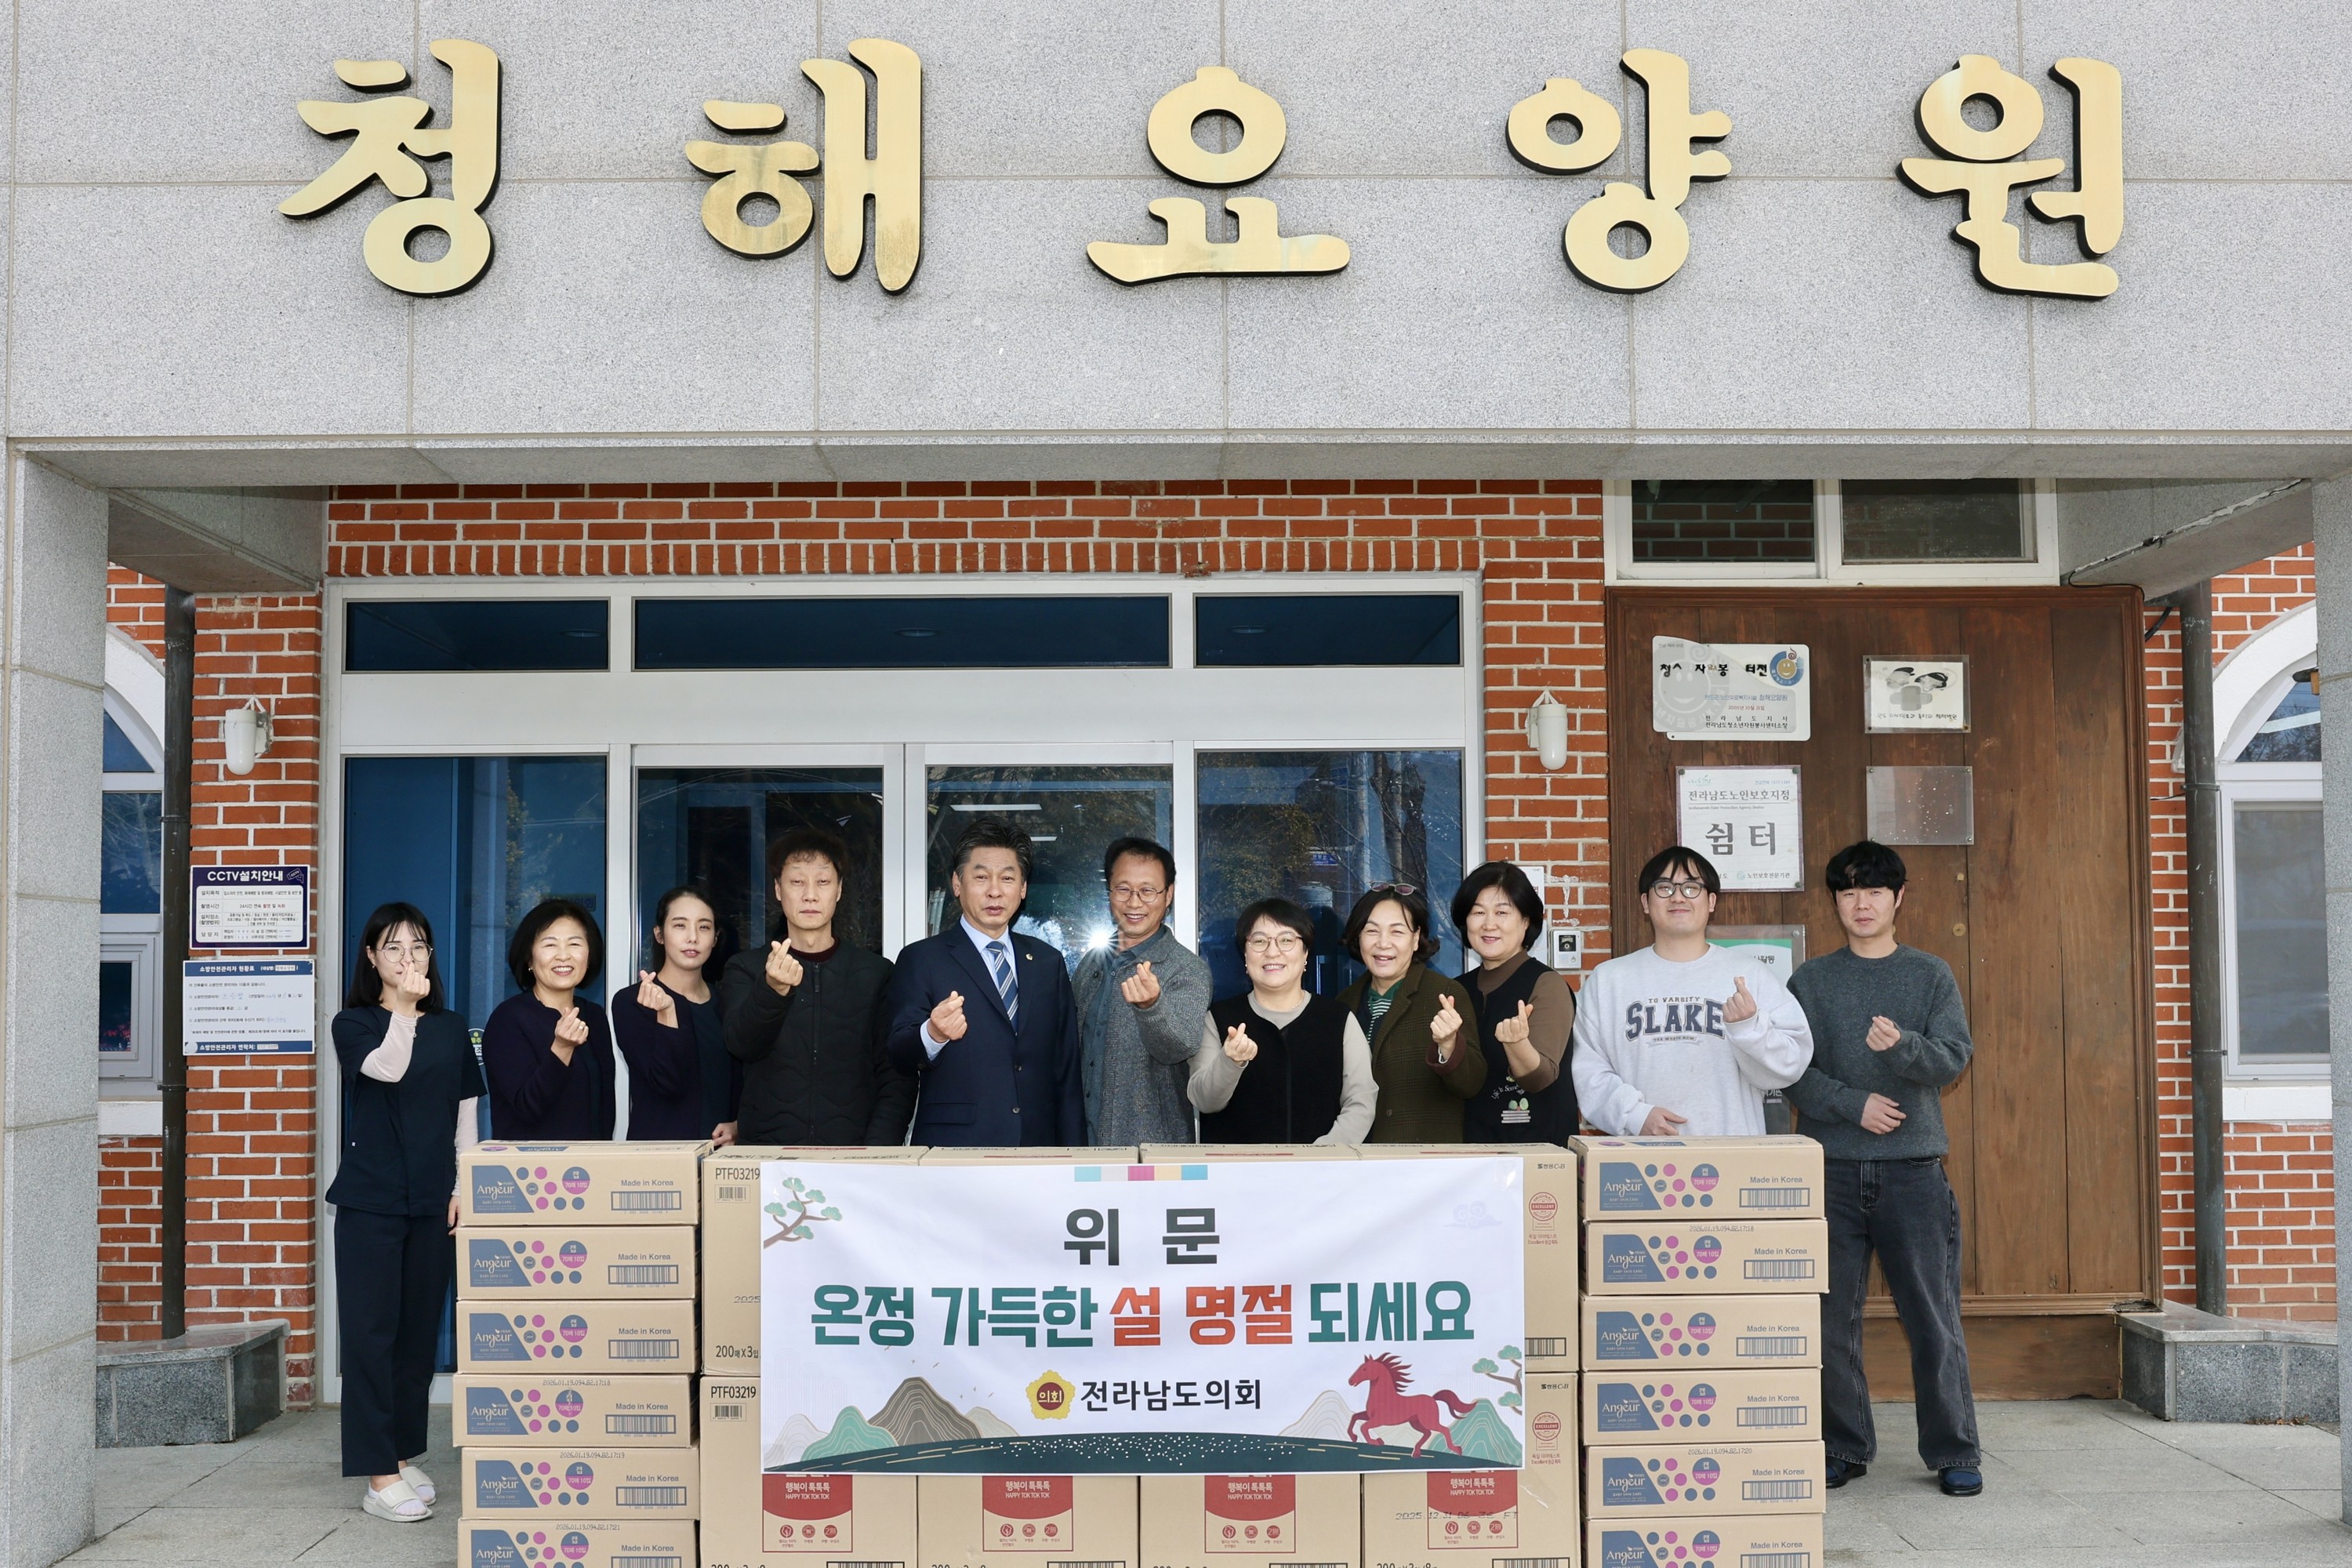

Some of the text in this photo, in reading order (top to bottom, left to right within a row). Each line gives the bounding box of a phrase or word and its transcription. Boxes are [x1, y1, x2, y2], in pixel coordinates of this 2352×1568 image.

[1688, 789, 1790, 801] 전라남도노인보호지정
[207, 870, 284, 881] CCTV설치안내
[1626, 998, 1725, 1042] SLAKE
[715, 1167, 760, 1180] PTF03219
[477, 1185, 514, 1200] Angeur
[1604, 1182, 1642, 1197] Angeur
[474, 1259, 512, 1274] Angeur
[1608, 1254, 1646, 1269] Angeur
[811, 1280, 1474, 1348] 온정 가득한 설 명절 되세요
[474, 1333, 512, 1348] Angeur
[1601, 1331, 1639, 1346] Angeur
[711, 1386, 757, 1399] PTF03219
[1038, 1389, 1062, 1403] 의회
[1081, 1379, 1261, 1412] 전라남도의회
[471, 1406, 509, 1421] Angeur
[1602, 1403, 1640, 1418] Angeur
[481, 1480, 519, 1494] Angeur
[786, 1482, 830, 1493] 행복이 톡톡톡
[1005, 1481, 1051, 1491] 행복이 톡톡톡
[1228, 1482, 1273, 1493] 행복이 톡톡톡
[1450, 1478, 1495, 1488] 행복이 톡톡톡
[1608, 1477, 1646, 1492] Angeur
[476, 1549, 514, 1564] Angeur
[1607, 1551, 1645, 1566] Angeur
